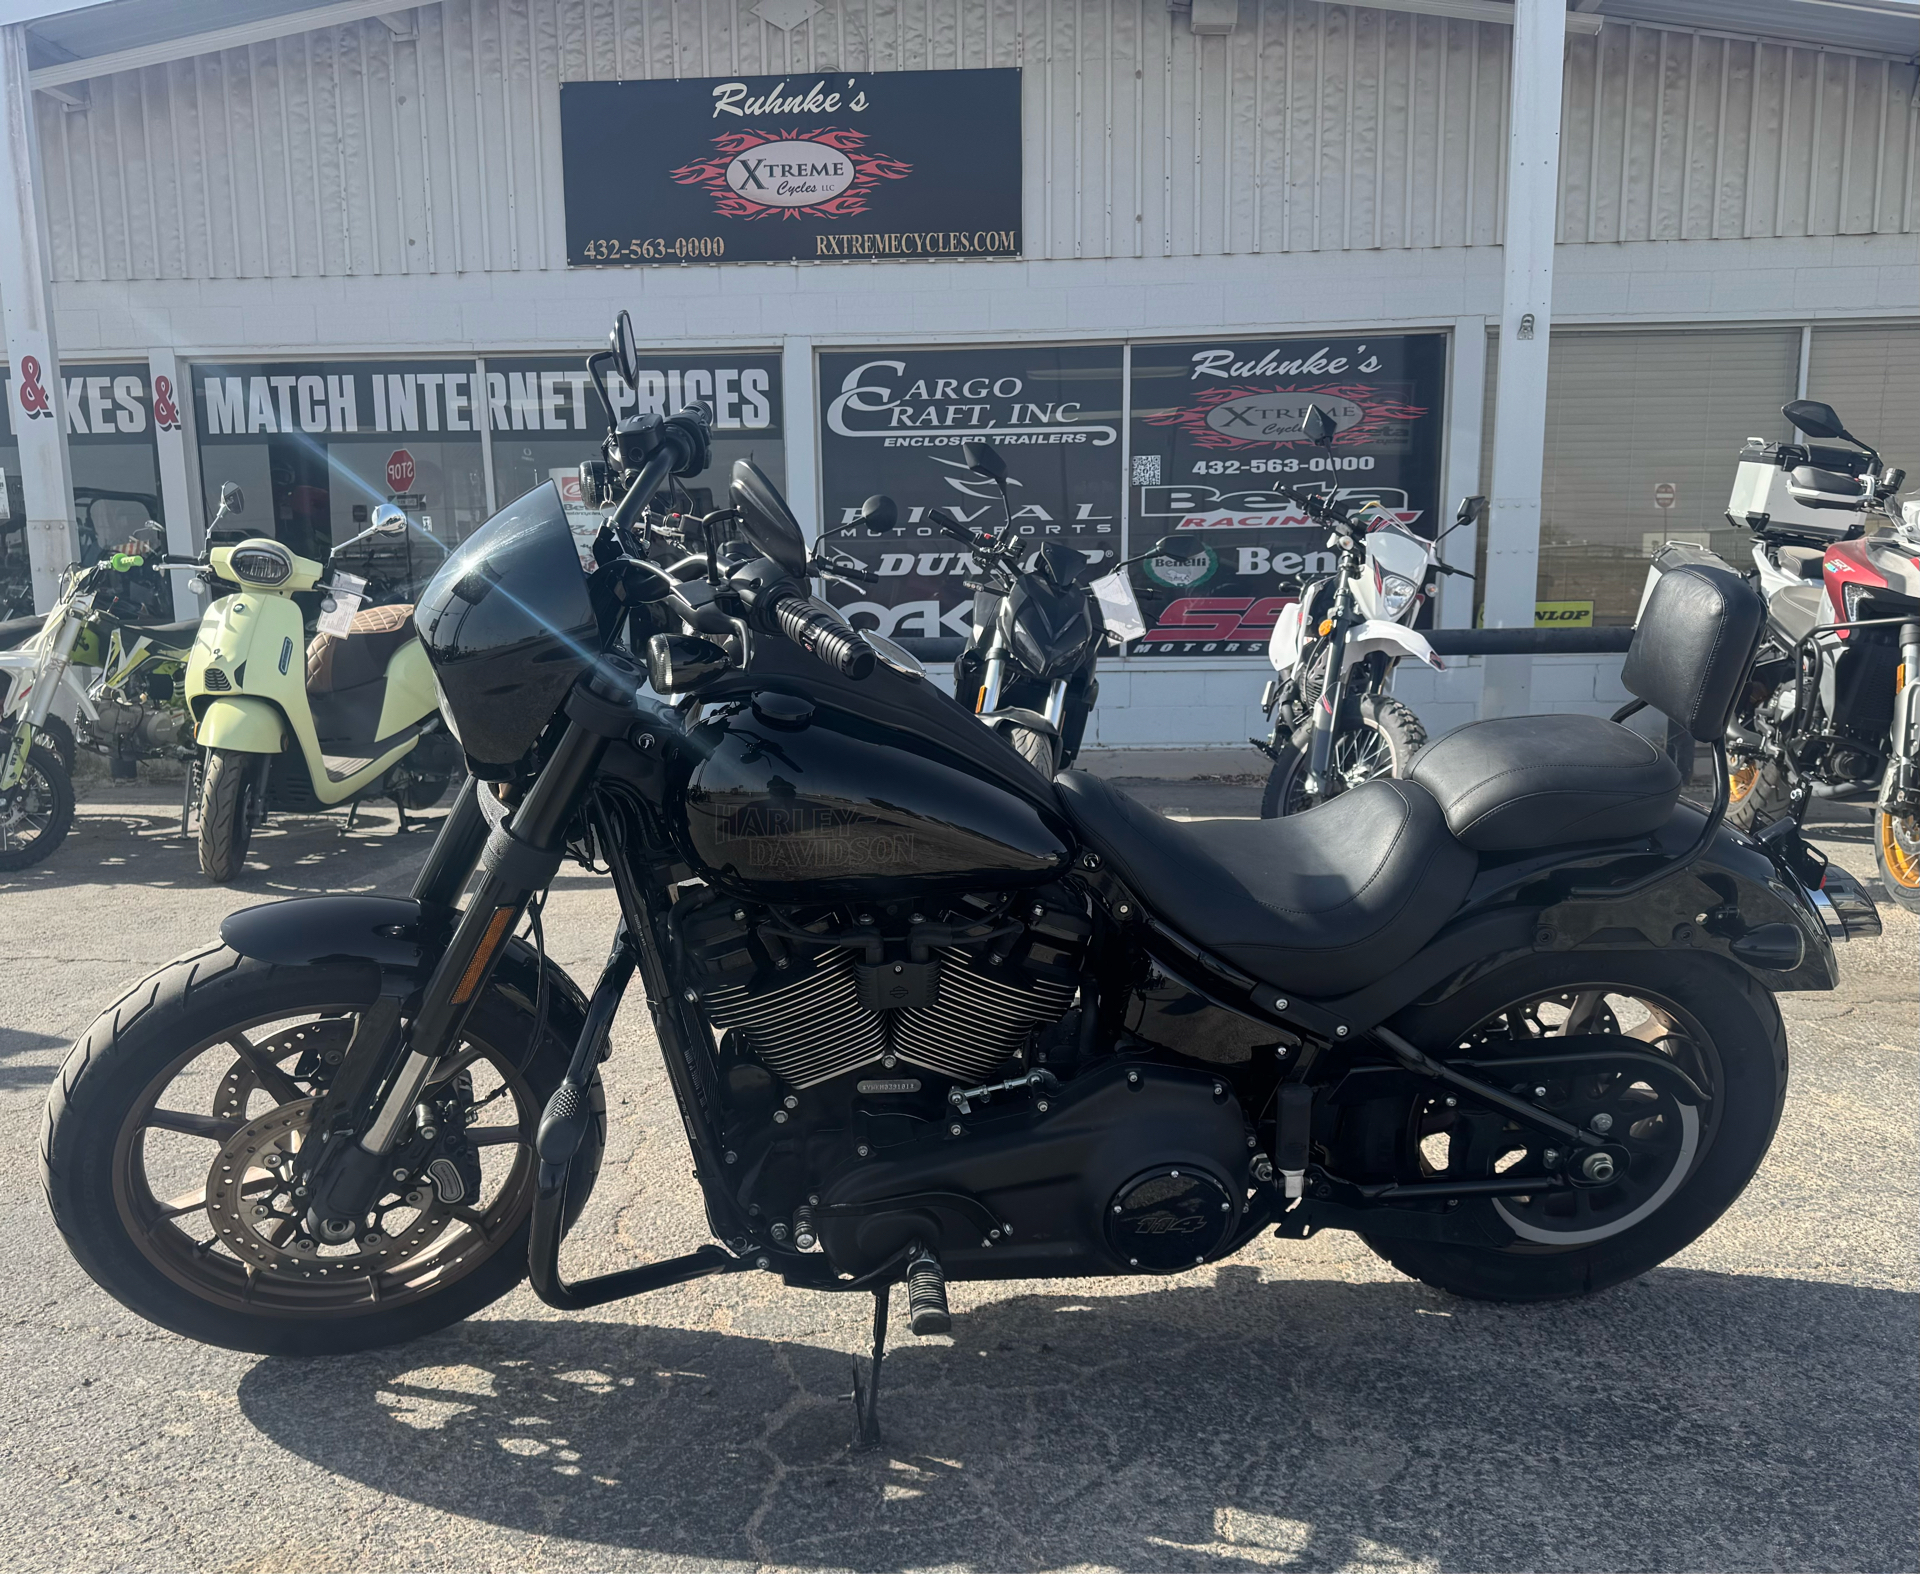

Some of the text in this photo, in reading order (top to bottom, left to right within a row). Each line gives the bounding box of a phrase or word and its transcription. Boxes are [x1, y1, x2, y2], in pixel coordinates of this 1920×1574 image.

[711, 79, 869, 118] Ruhnke's
[736, 158, 844, 190] XTREME
[777, 180, 817, 196] Cycles
[584, 230, 1016, 259] 432-563-0000 RXTREMECYCLES.COM
[1191, 345, 1382, 380] Ruhnke's
[20, 355, 54, 420] &
[842, 360, 1023, 411] CARGO
[154, 375, 182, 432] &
[204, 369, 770, 434] MATCH INTERNET PRICES
[1007, 402, 1081, 424] INC
[884, 433, 1087, 447] ENCLOSED TRAILERS
[1192, 456, 1375, 475] 432-563-0000
[840, 524, 1112, 538] MTOSPORTS
[1180, 515, 1311, 528] RACIN
[1236, 546, 1338, 576] Ben
[838, 600, 974, 638] OAK
[1534, 610, 1590, 621] NLOP
[751, 833, 918, 868] DAVIDSON
[1135, 1216, 1207, 1234] 114
